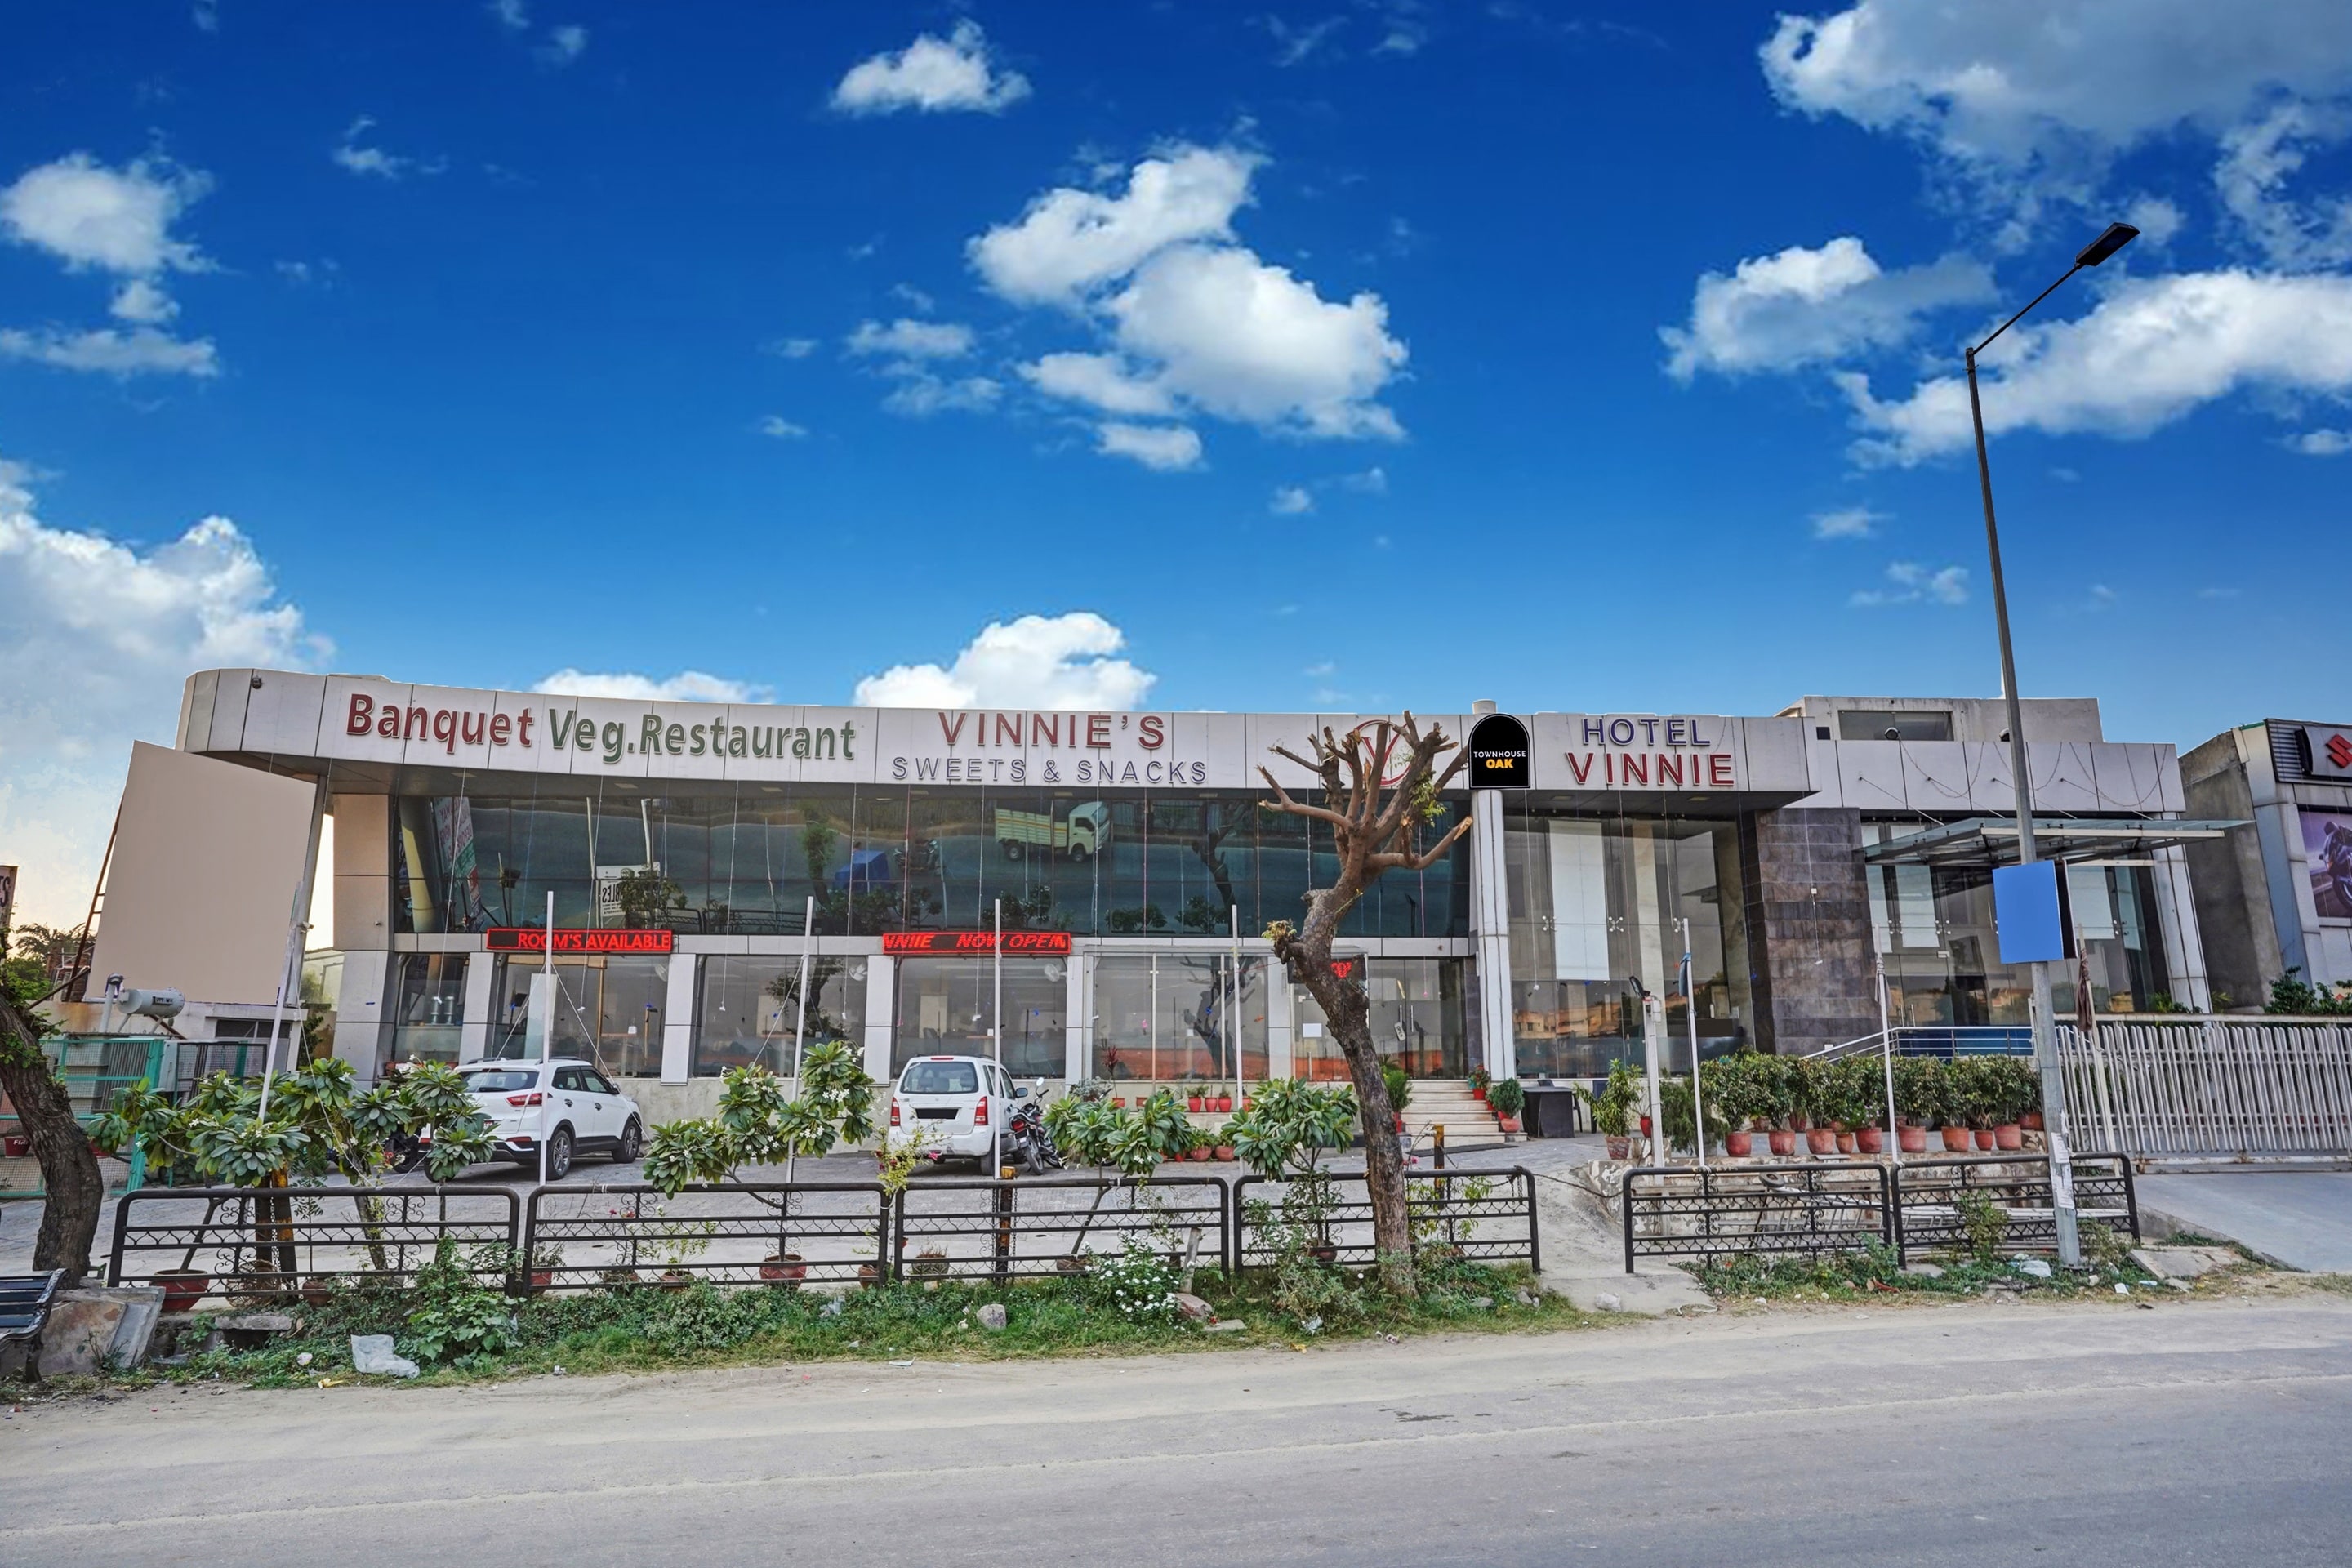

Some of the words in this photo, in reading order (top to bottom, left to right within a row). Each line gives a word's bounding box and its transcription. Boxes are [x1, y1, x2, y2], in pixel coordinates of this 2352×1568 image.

[347, 693, 533, 754] Banquet
[549, 708, 856, 764] Veg.Restaurant
[938, 711, 1165, 749] VINNIE'S
[1582, 719, 1711, 746] HOTEL
[892, 756, 1027, 782] SWEETS
[1043, 760, 1061, 782] &
[1076, 760, 1207, 784] SNACKS
[1486, 758, 1514, 768] OAK
[1566, 752, 1734, 786] VINNIE
[518, 933, 581, 948] ROOM'S
[586, 934, 670, 949] AVAILABLE
[956, 933, 1006, 948] NOW
